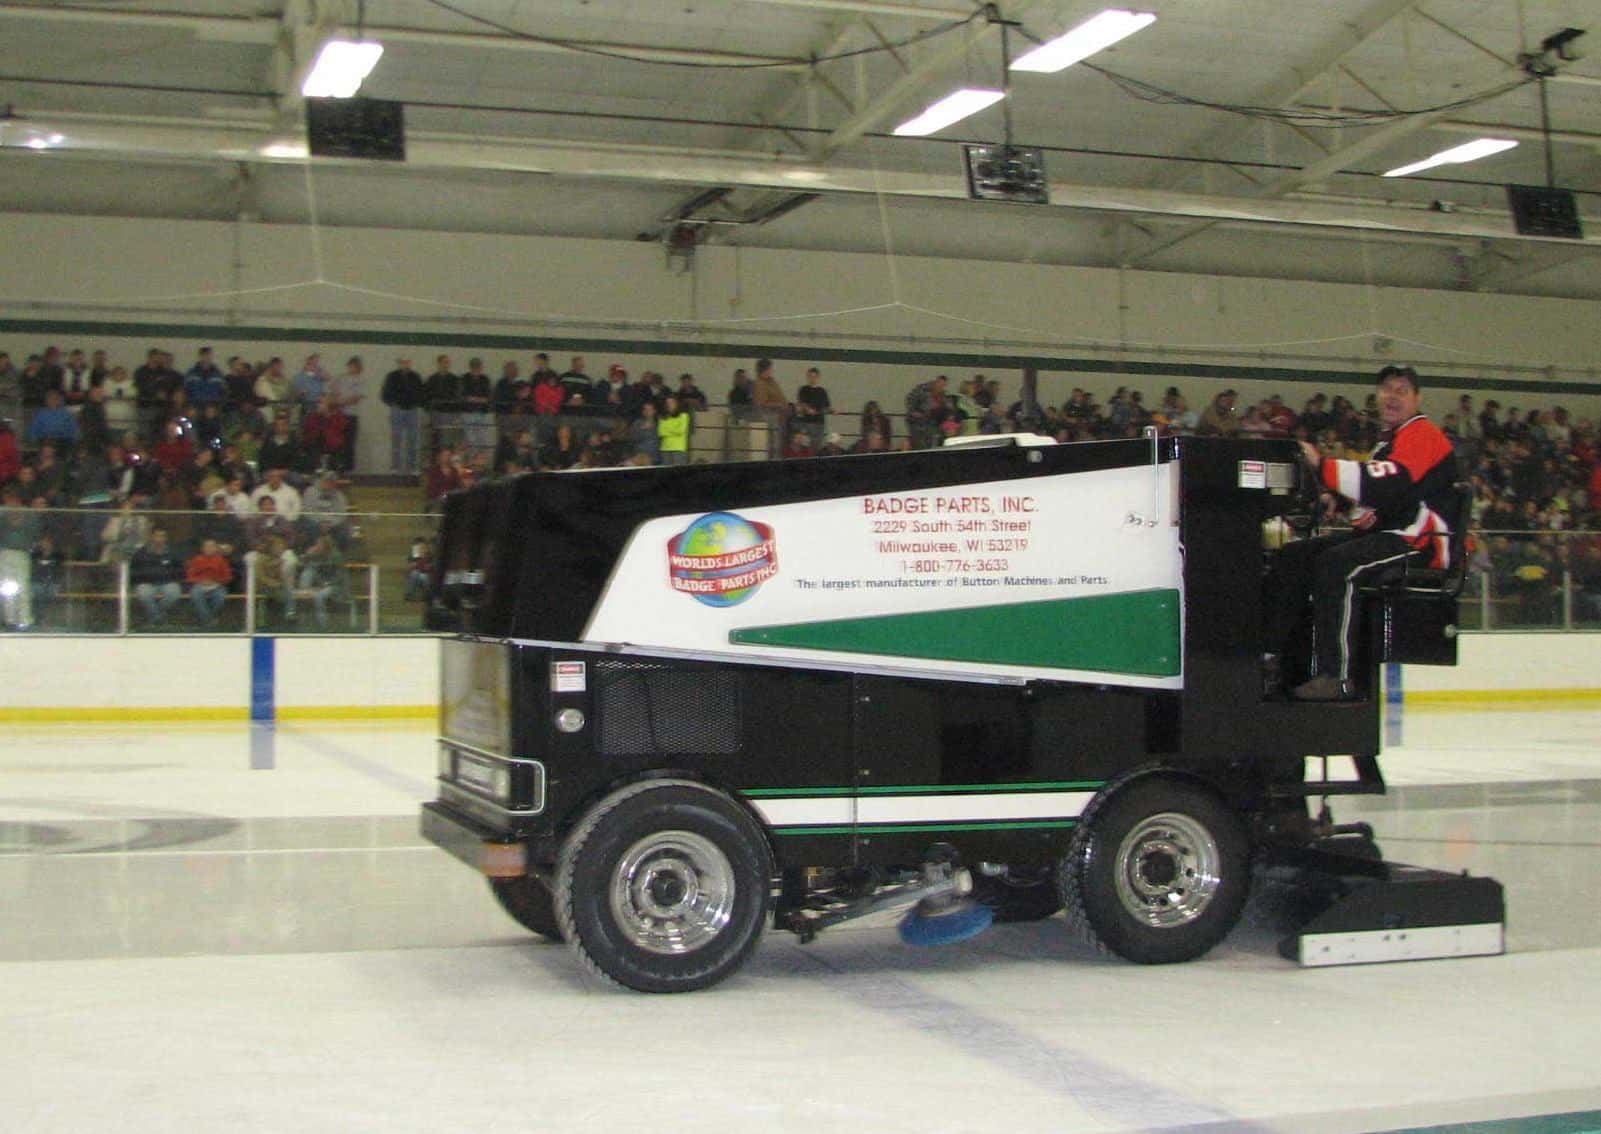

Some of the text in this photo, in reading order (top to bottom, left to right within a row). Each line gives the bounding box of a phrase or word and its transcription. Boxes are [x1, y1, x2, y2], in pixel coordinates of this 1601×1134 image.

[864, 496, 1040, 515] BADGE PARTS, INC.
[873, 518, 1031, 534] 2229 South 54th Street
[725, 541, 774, 564] LARGEST
[879, 538, 1028, 554] Milwaukee, WI 53219
[903, 558, 1008, 573] 1-800-776-3633
[675, 576, 716, 592] BADGE
[721, 573, 755, 590] PARTS
[796, 578, 818, 589] The
[822, 578, 861, 591] largest
[866, 578, 941, 589] manufacturer
[946, 577, 959, 588] of
[962, 576, 999, 587] Button
[1004, 575, 1053, 587] Machines
[1057, 575, 1077, 586] and
